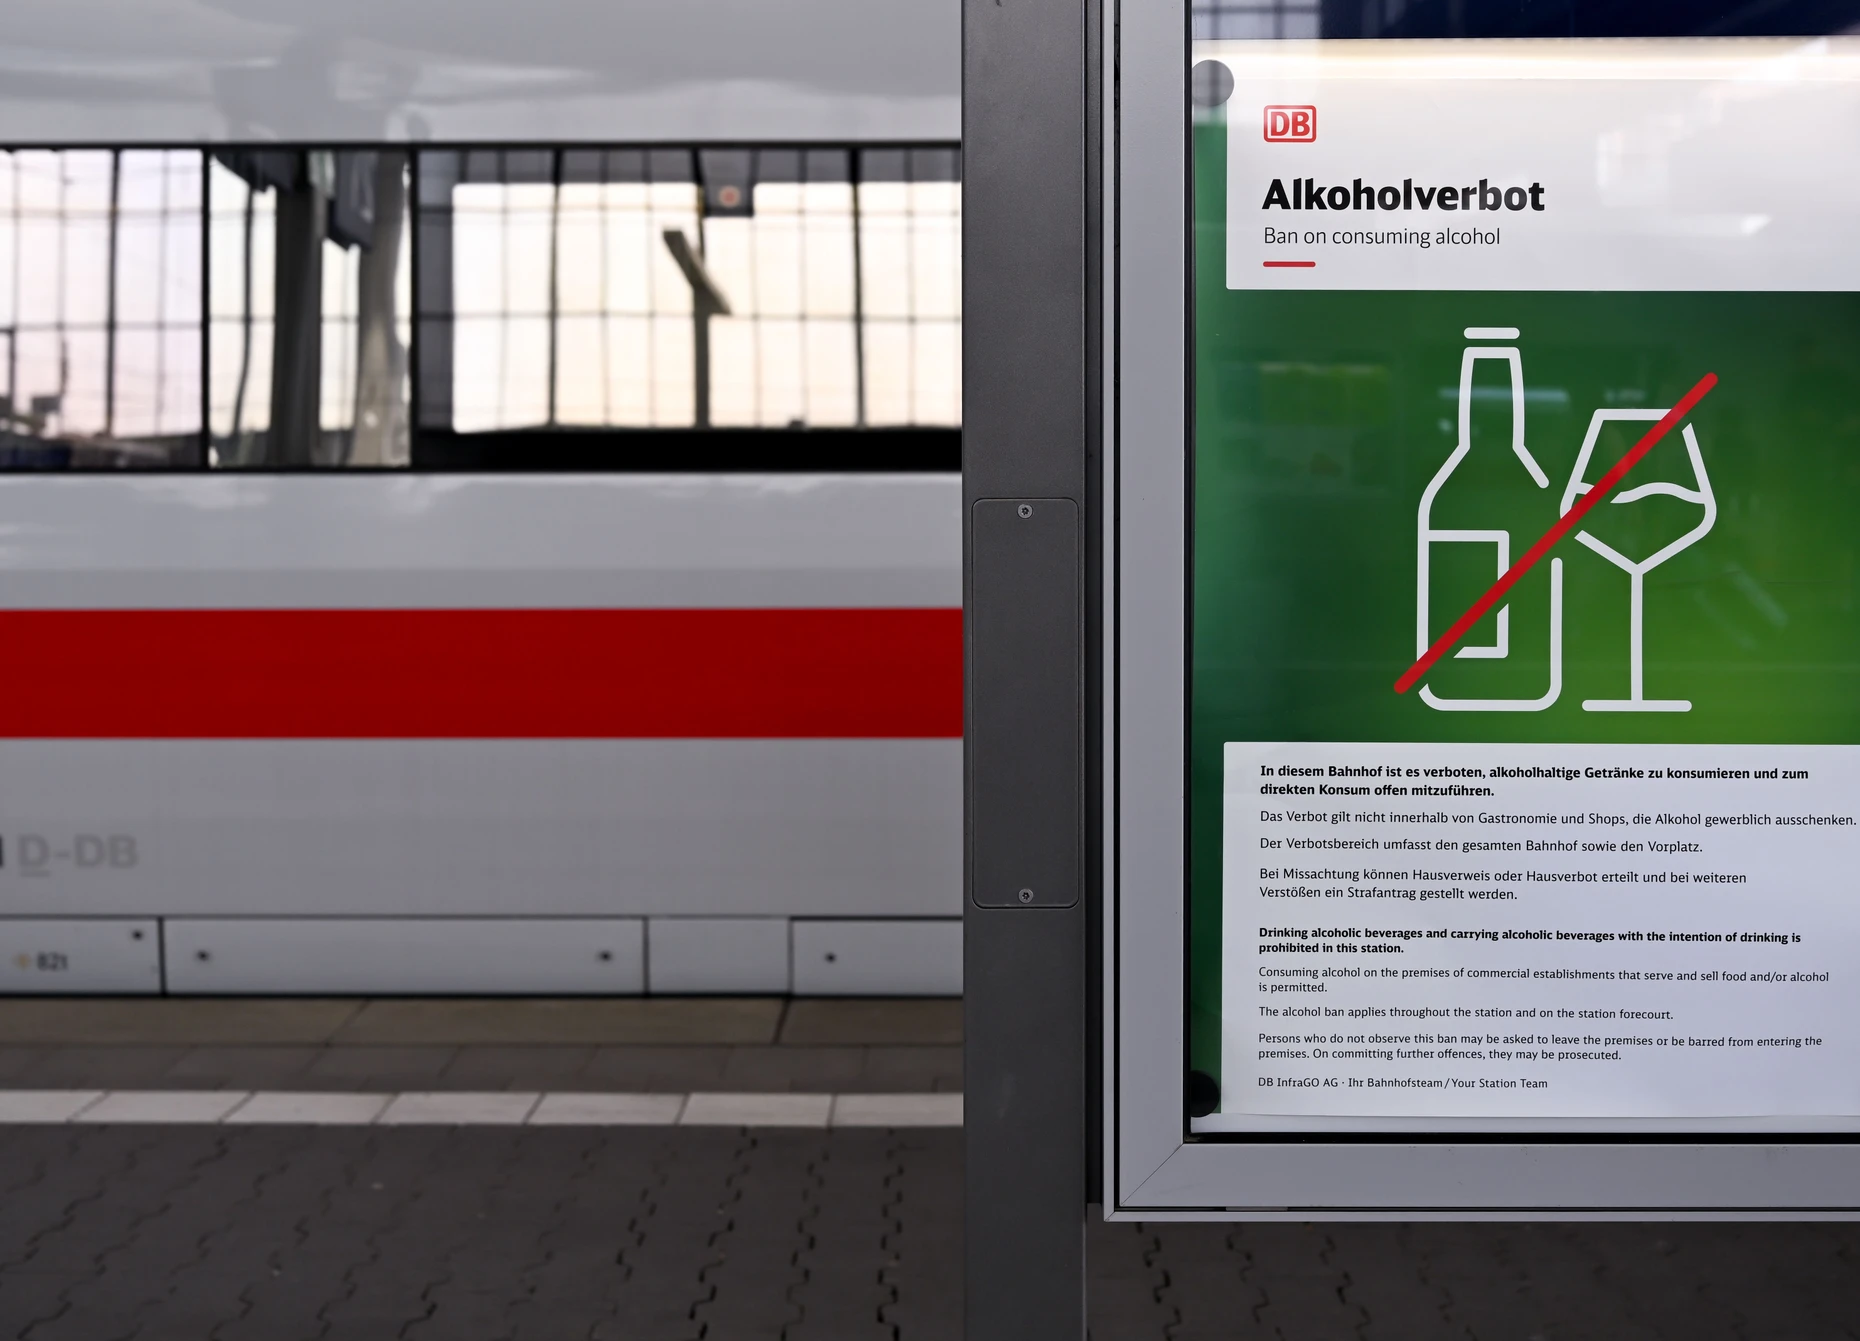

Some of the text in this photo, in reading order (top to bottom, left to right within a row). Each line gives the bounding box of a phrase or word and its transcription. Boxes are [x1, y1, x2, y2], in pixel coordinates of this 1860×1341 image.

[1271, 112, 1310, 136] DB
[1262, 178, 1545, 211] Alkoholverbot
[1265, 227, 1499, 248] Ban on consuming alcohol
[1260, 765, 1809, 782] In diesem Bahnhof ist es verboten, alkoholhaltige Getränke zu konsumieren und zum
[1259, 784, 1495, 797] direkten Konsum offen mitzuführen.
[1260, 811, 1857, 828] Das Verbot gilt nicht innerhalb von Gastronomie und Shops, die Alkohol gewerblich ausschenken.
[18, 834, 138, 868] D-DB
[1260, 838, 1703, 855] Der Verbotsbereich umfasst den gesamten Bahnhof sowie den Vorplatz.
[1259, 868, 1747, 884] Bei Missachtung können Hausverweis oder Hausverbot erteilt und bei weiteren
[1259, 886, 1518, 902] Verstößen ein Strafantrag gestellt werden.
[1259, 927, 1802, 946] Drinking alcoholic beverages and carrying alcoholic beverages with the intention of drinking is
[1258, 943, 1405, 955] prohibited in this station.
[1258, 967, 1830, 984] Consuming alcohol on the premises of commercial establishments that serve and sell food and/or alcohol
[1258, 982, 1328, 995] is permitted.
[1258, 1007, 1674, 1020] The alcohol ban applies throughout the station and on the station forecourt.
[1258, 1033, 1823, 1049] Persons who do not observe this ban may be asked to leave the premises or be barred from entering the
[1258, 1048, 1622, 1062] premises. On committing further offences, they may be prosecuted.
[1258, 1077, 1274, 1087] DB
[1276, 1078, 1320, 1088] InfraGO
[1322, 1078, 1339, 1088] AG
[1348, 1078, 1365, 1088] Ihr
[1478, 1078, 1517, 1089] Station
[1519, 1079, 1548, 1089] Team
